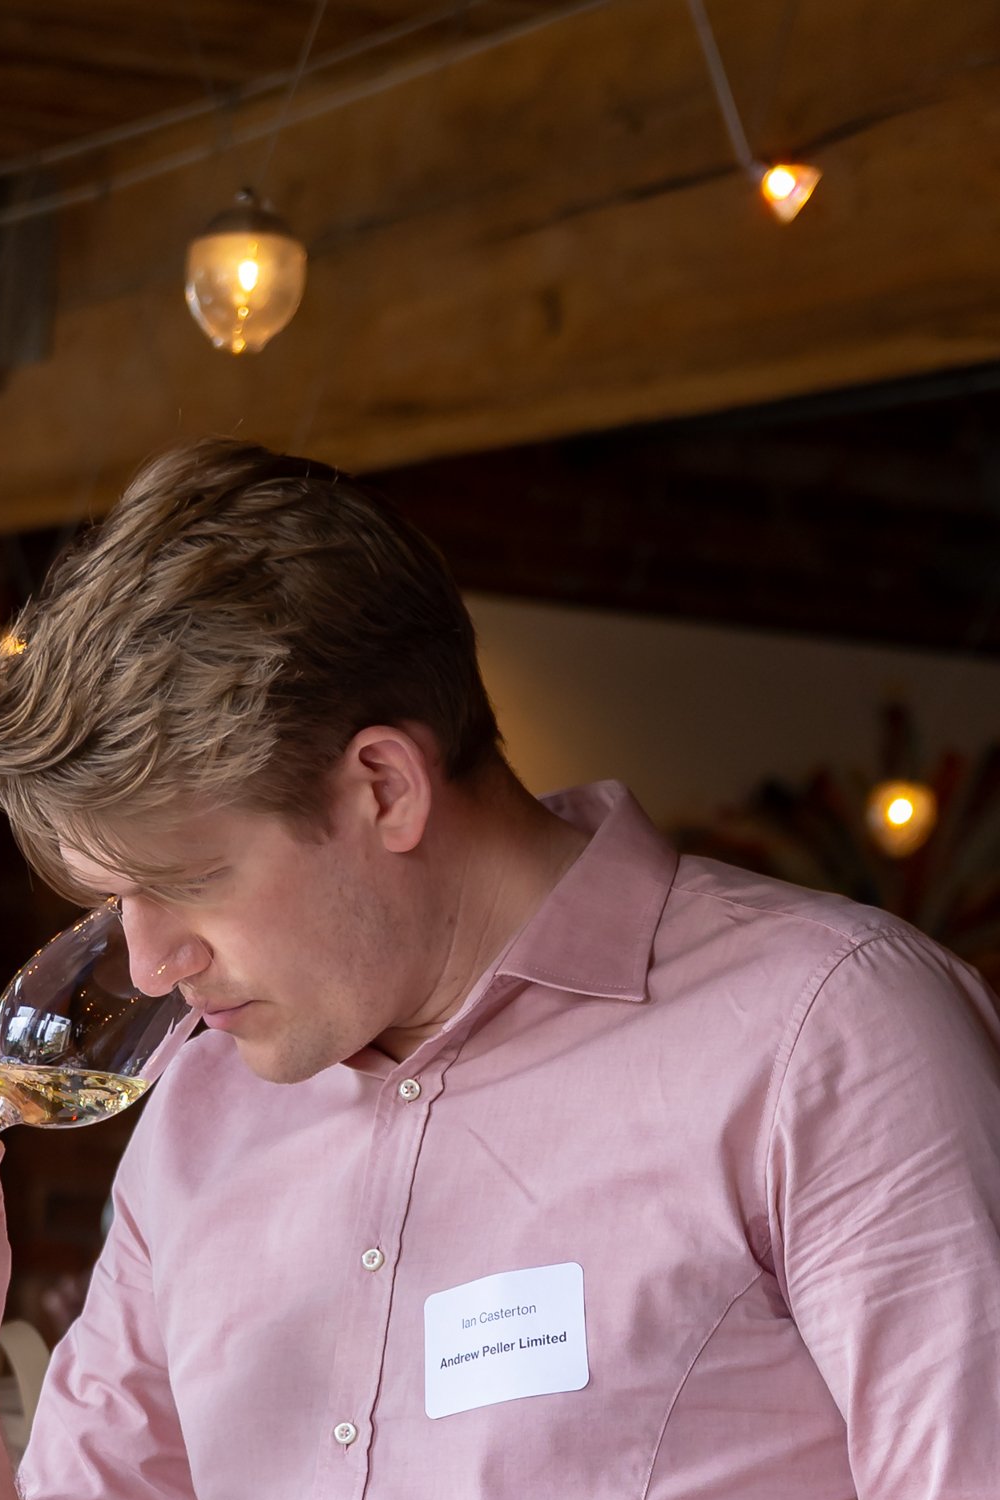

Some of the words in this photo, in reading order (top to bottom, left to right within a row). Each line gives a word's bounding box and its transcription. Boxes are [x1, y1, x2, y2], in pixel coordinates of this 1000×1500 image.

[462, 1317, 476, 1330] Ian
[479, 1304, 537, 1324] Casterton
[440, 1350, 480, 1370] Andrew
[482, 1341, 515, 1357] Peller
[519, 1331, 567, 1349] Limited
